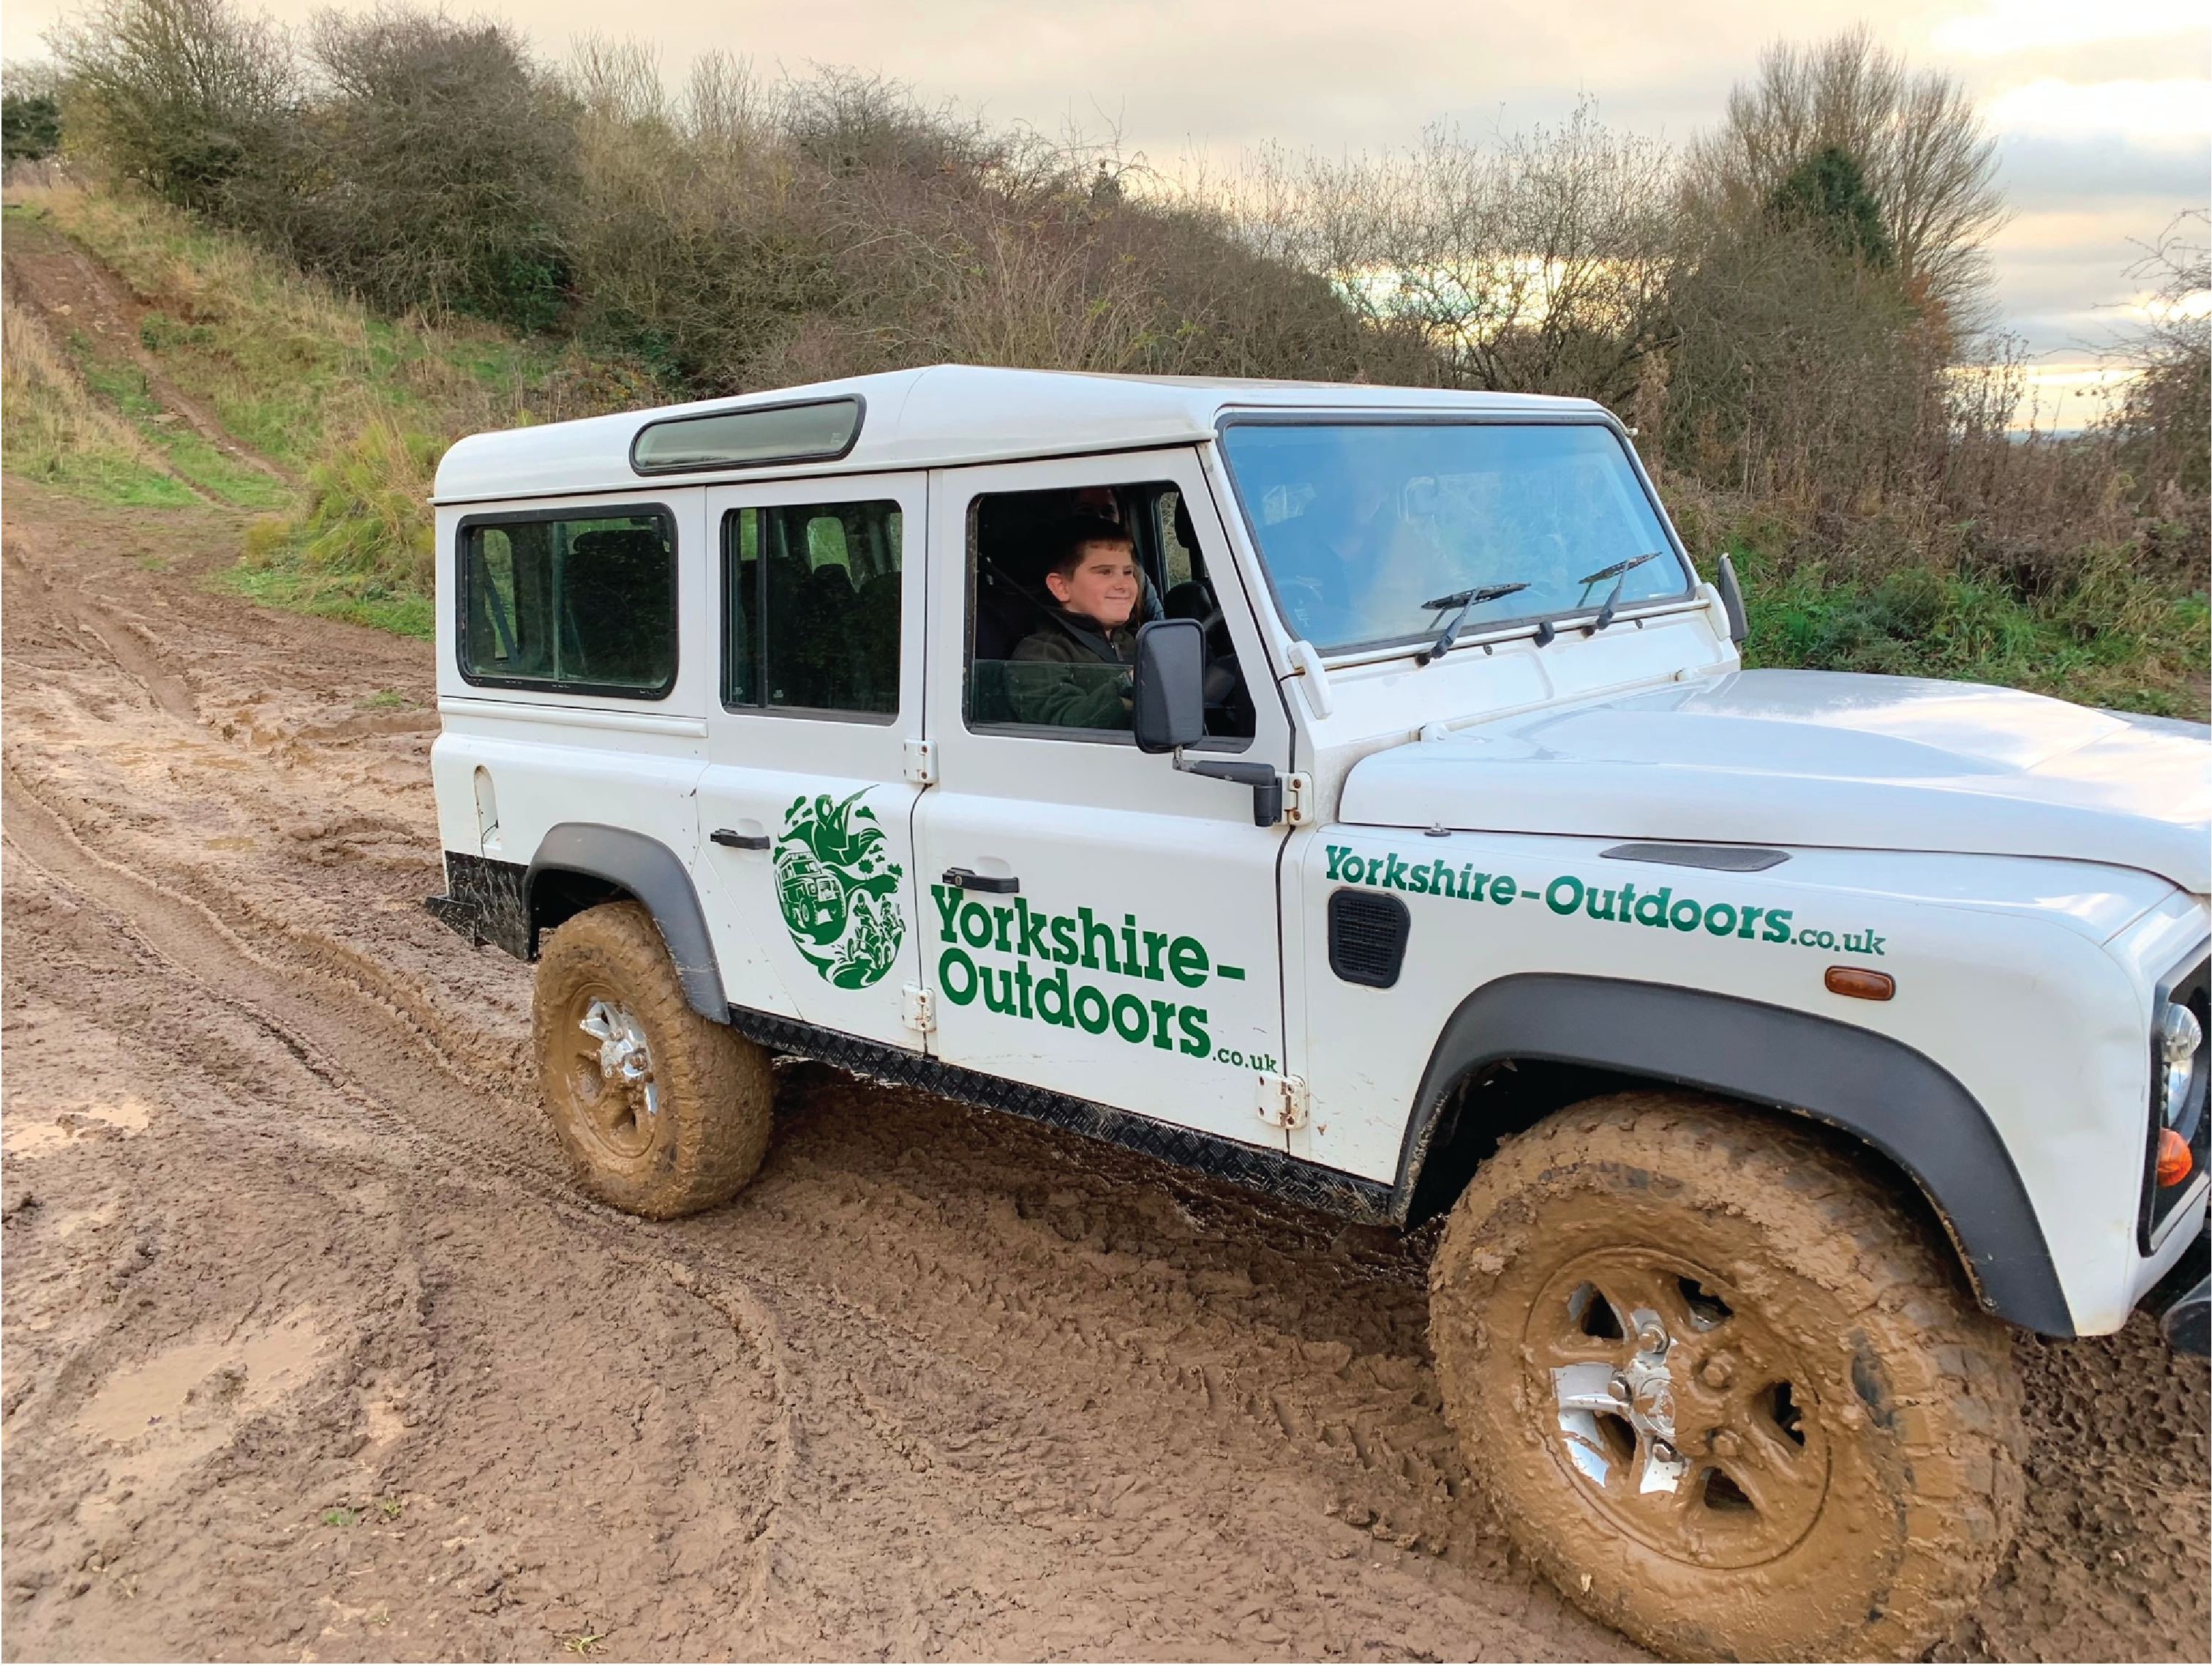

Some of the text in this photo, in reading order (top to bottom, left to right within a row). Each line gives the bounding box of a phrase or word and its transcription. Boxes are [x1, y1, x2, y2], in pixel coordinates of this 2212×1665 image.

[930, 884, 1246, 988] Yorkshire-
[1325, 845, 1886, 955] Yorkshire-Outdoors.co.uk
[938, 947, 1278, 1073] Outdoors.co.uk
